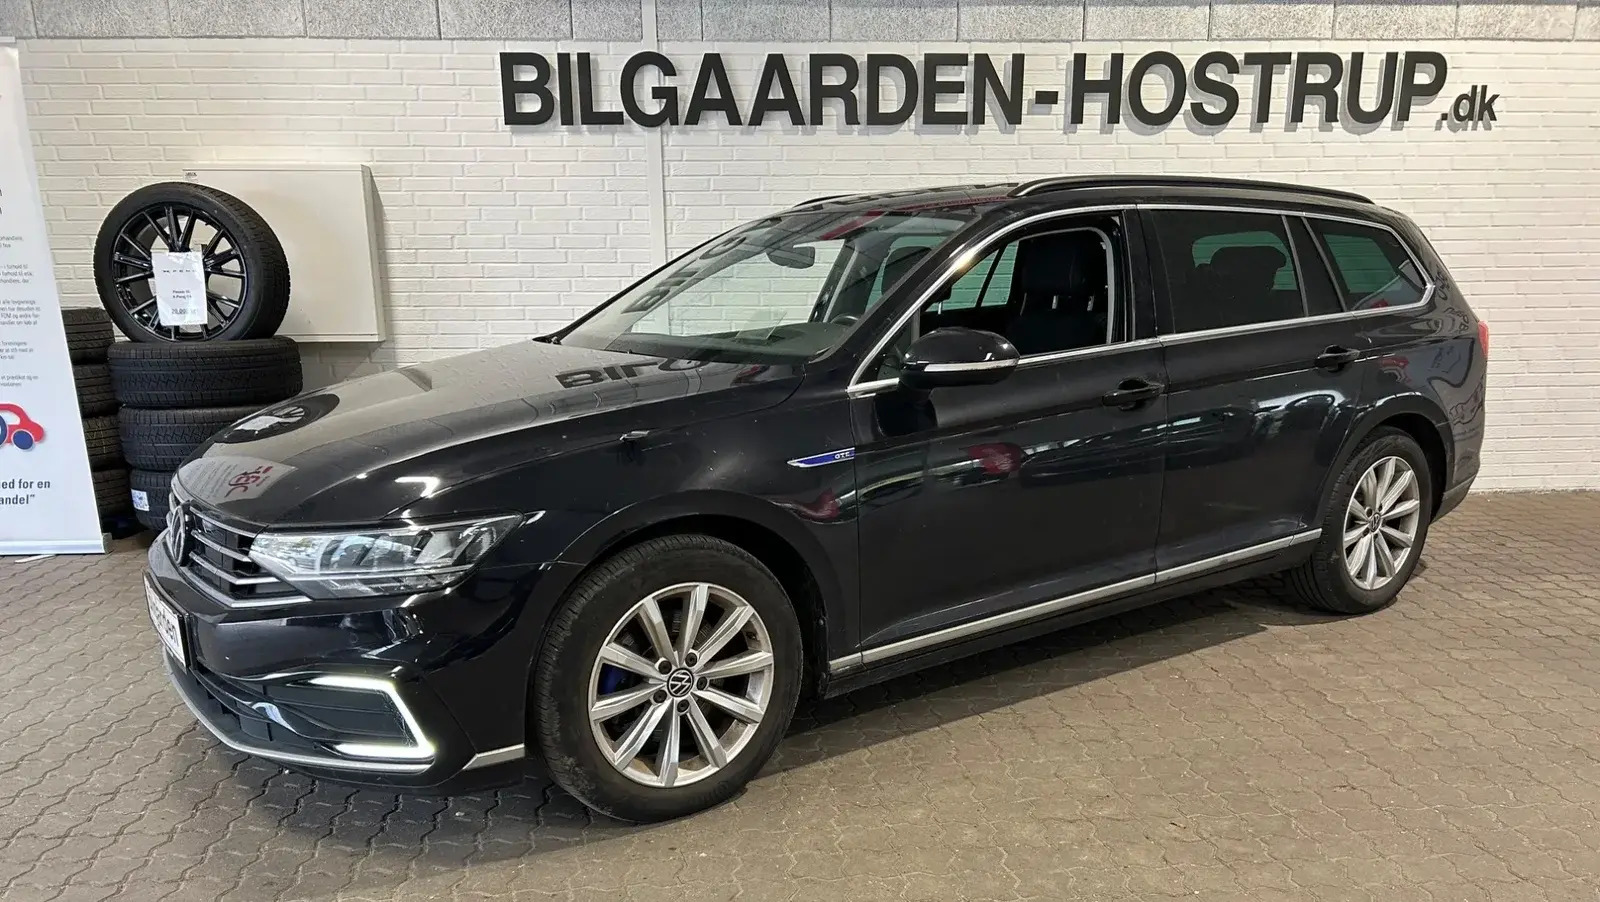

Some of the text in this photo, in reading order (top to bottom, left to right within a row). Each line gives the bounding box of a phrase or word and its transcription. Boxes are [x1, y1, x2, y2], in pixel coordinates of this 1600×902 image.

[0, 478, 51, 489] ed for en
